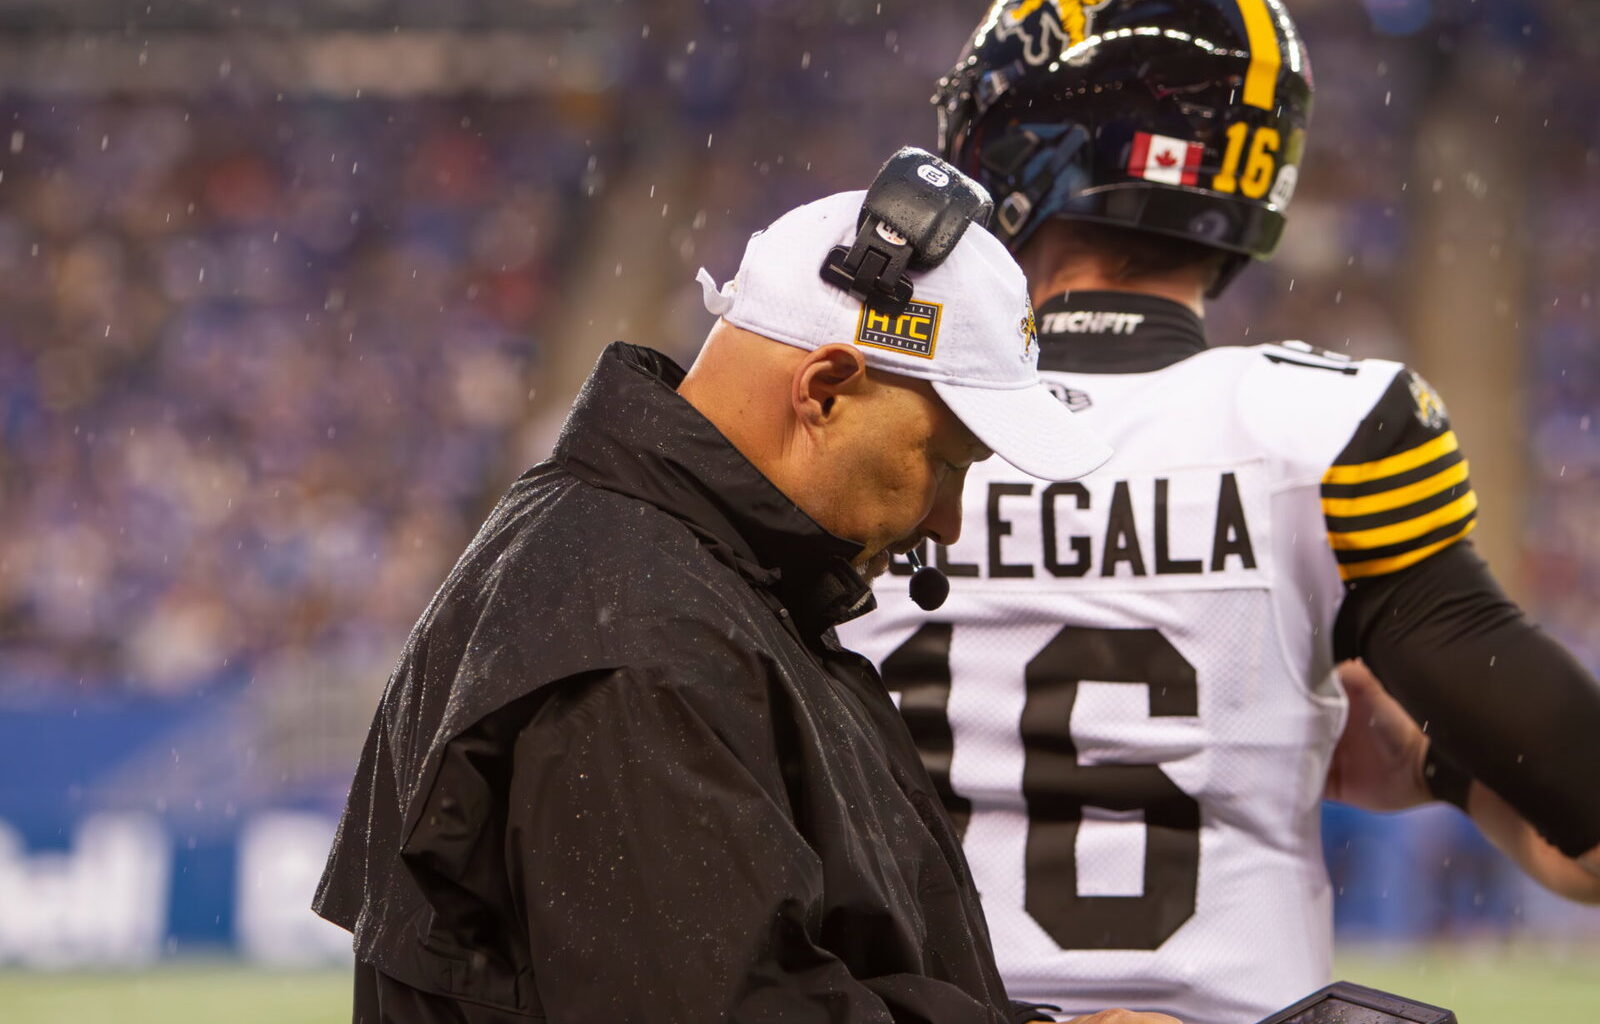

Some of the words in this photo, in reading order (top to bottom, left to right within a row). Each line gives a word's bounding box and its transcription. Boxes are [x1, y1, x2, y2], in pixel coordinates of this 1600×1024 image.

[1212, 121, 1280, 199] 16
[867, 308, 931, 340] HTC
[1041, 311, 1144, 335] TECHFIT
[866, 333, 926, 352] TRAINING
